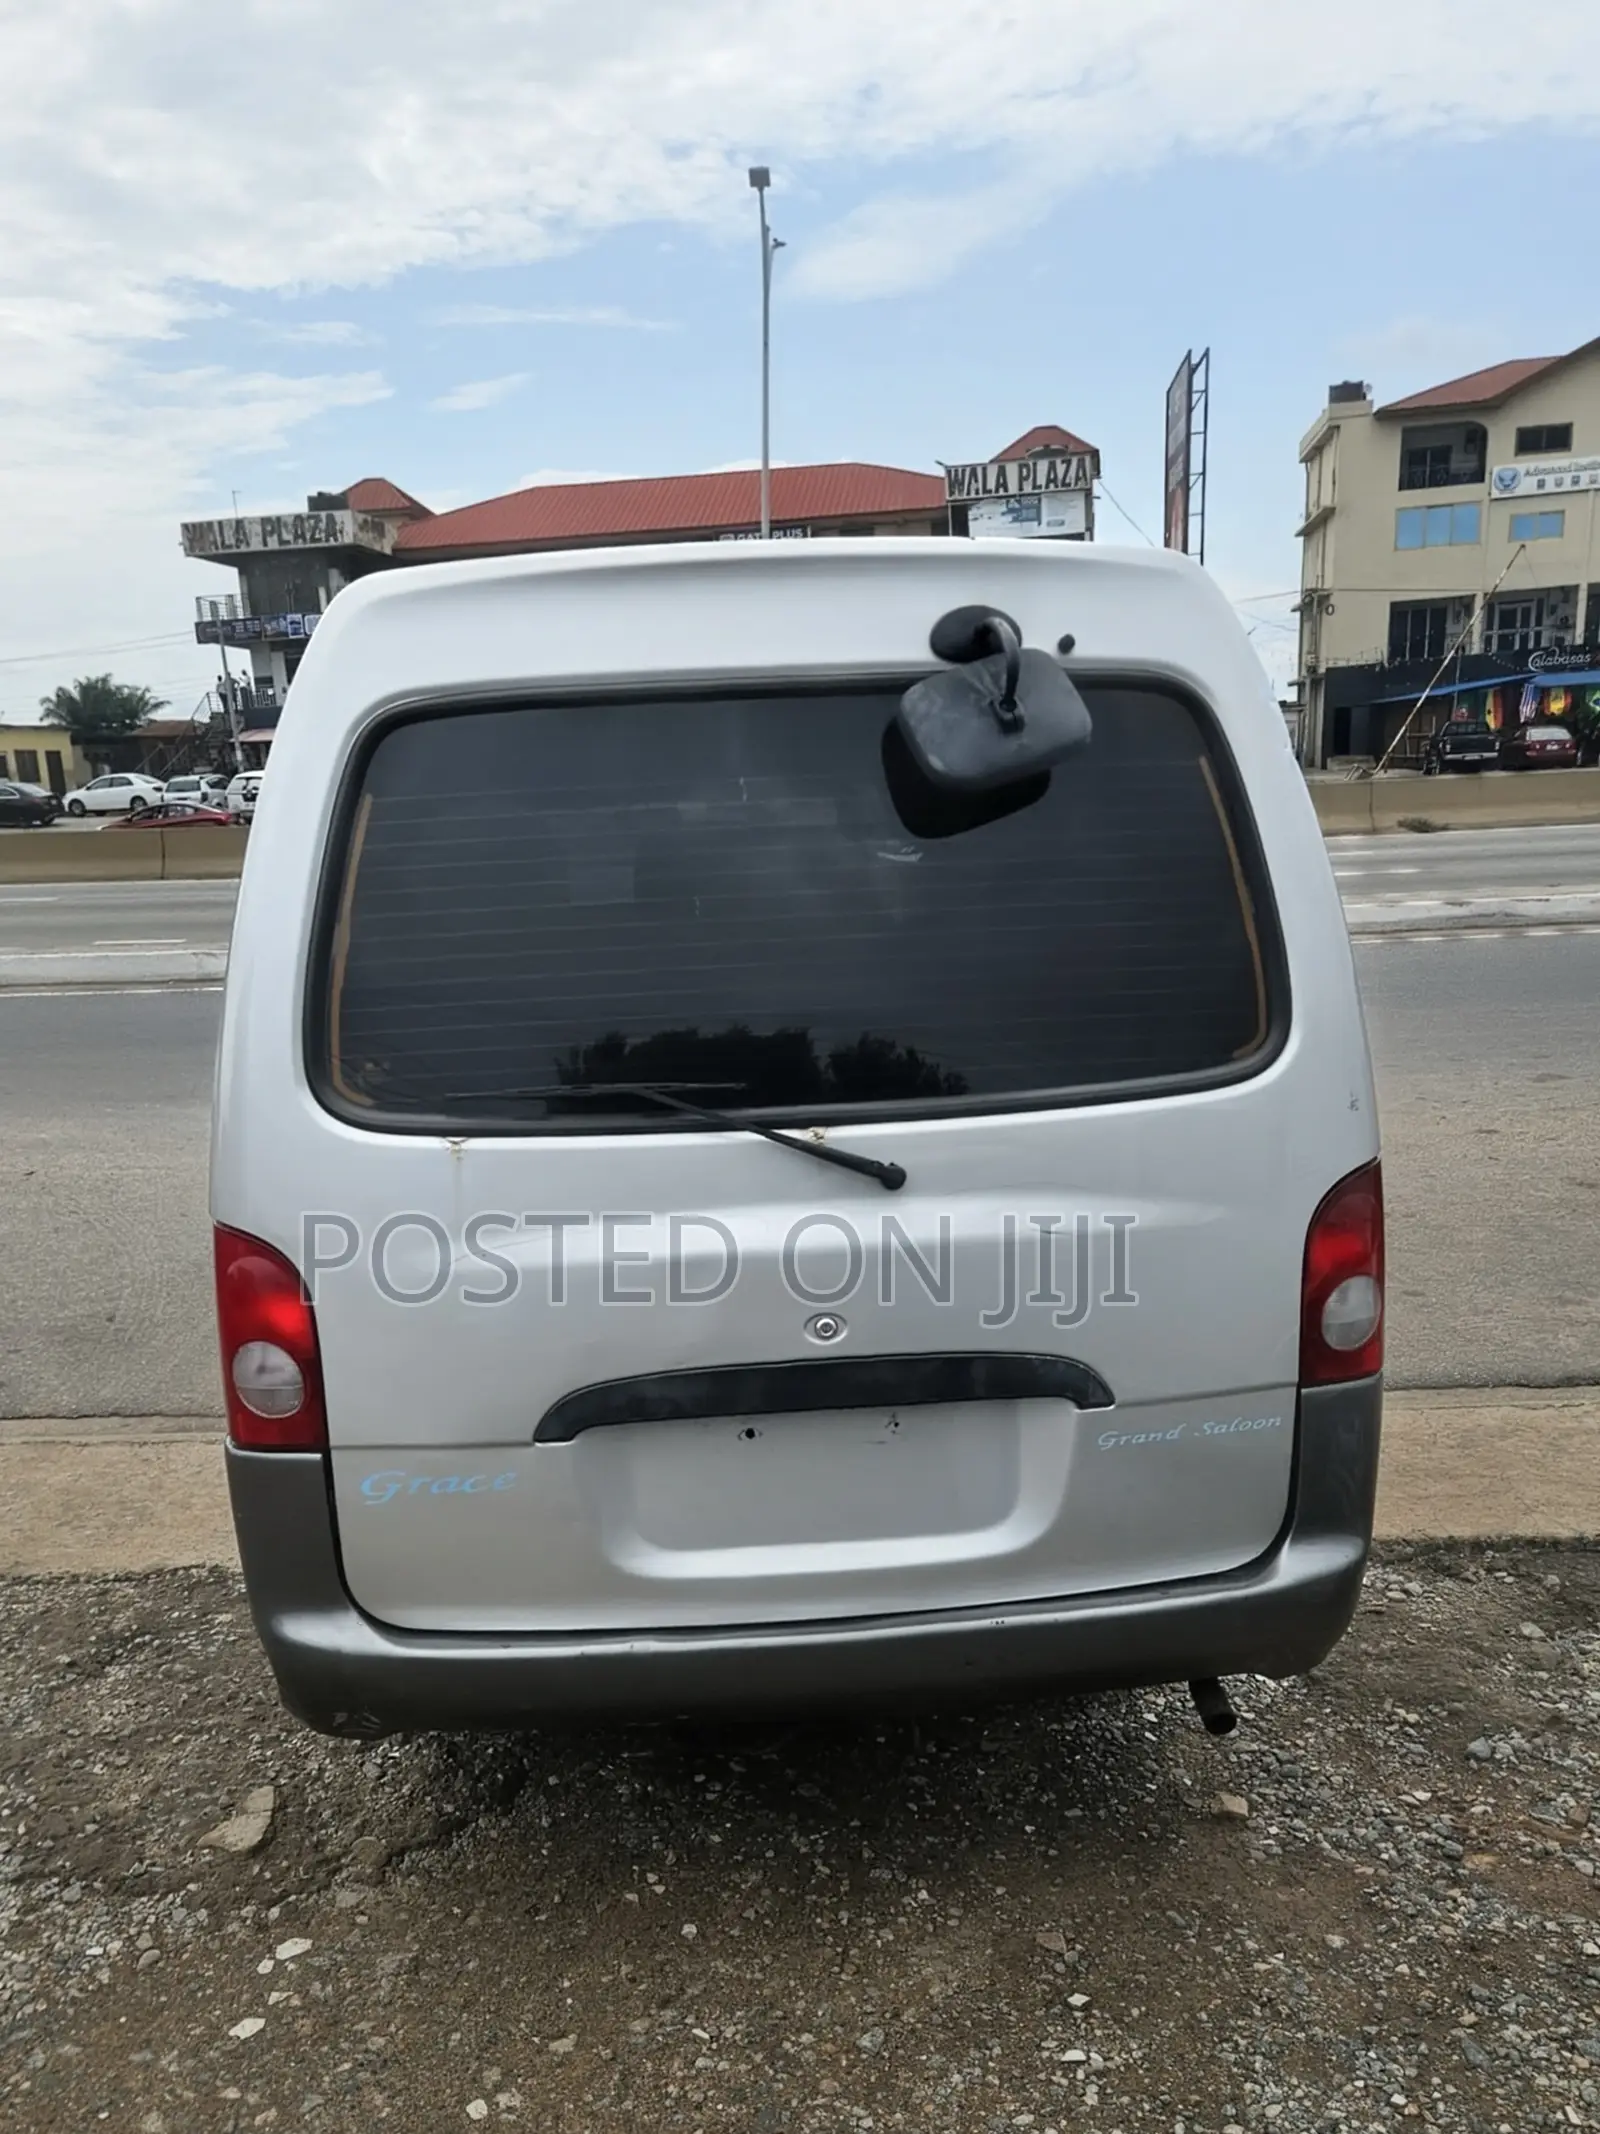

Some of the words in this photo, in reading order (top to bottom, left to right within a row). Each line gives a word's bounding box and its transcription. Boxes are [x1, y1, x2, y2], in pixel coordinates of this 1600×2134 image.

[946, 464, 1009, 497] WALA
[1018, 458, 1088, 492] PLAZA
[261, 512, 338, 548] PLAZA
[1528, 646, 1591, 672] Calabasas
[1098, 1423, 1187, 1451] Grand
[1203, 1416, 1281, 1435] Saloon
[360, 1469, 518, 1505] Grace
